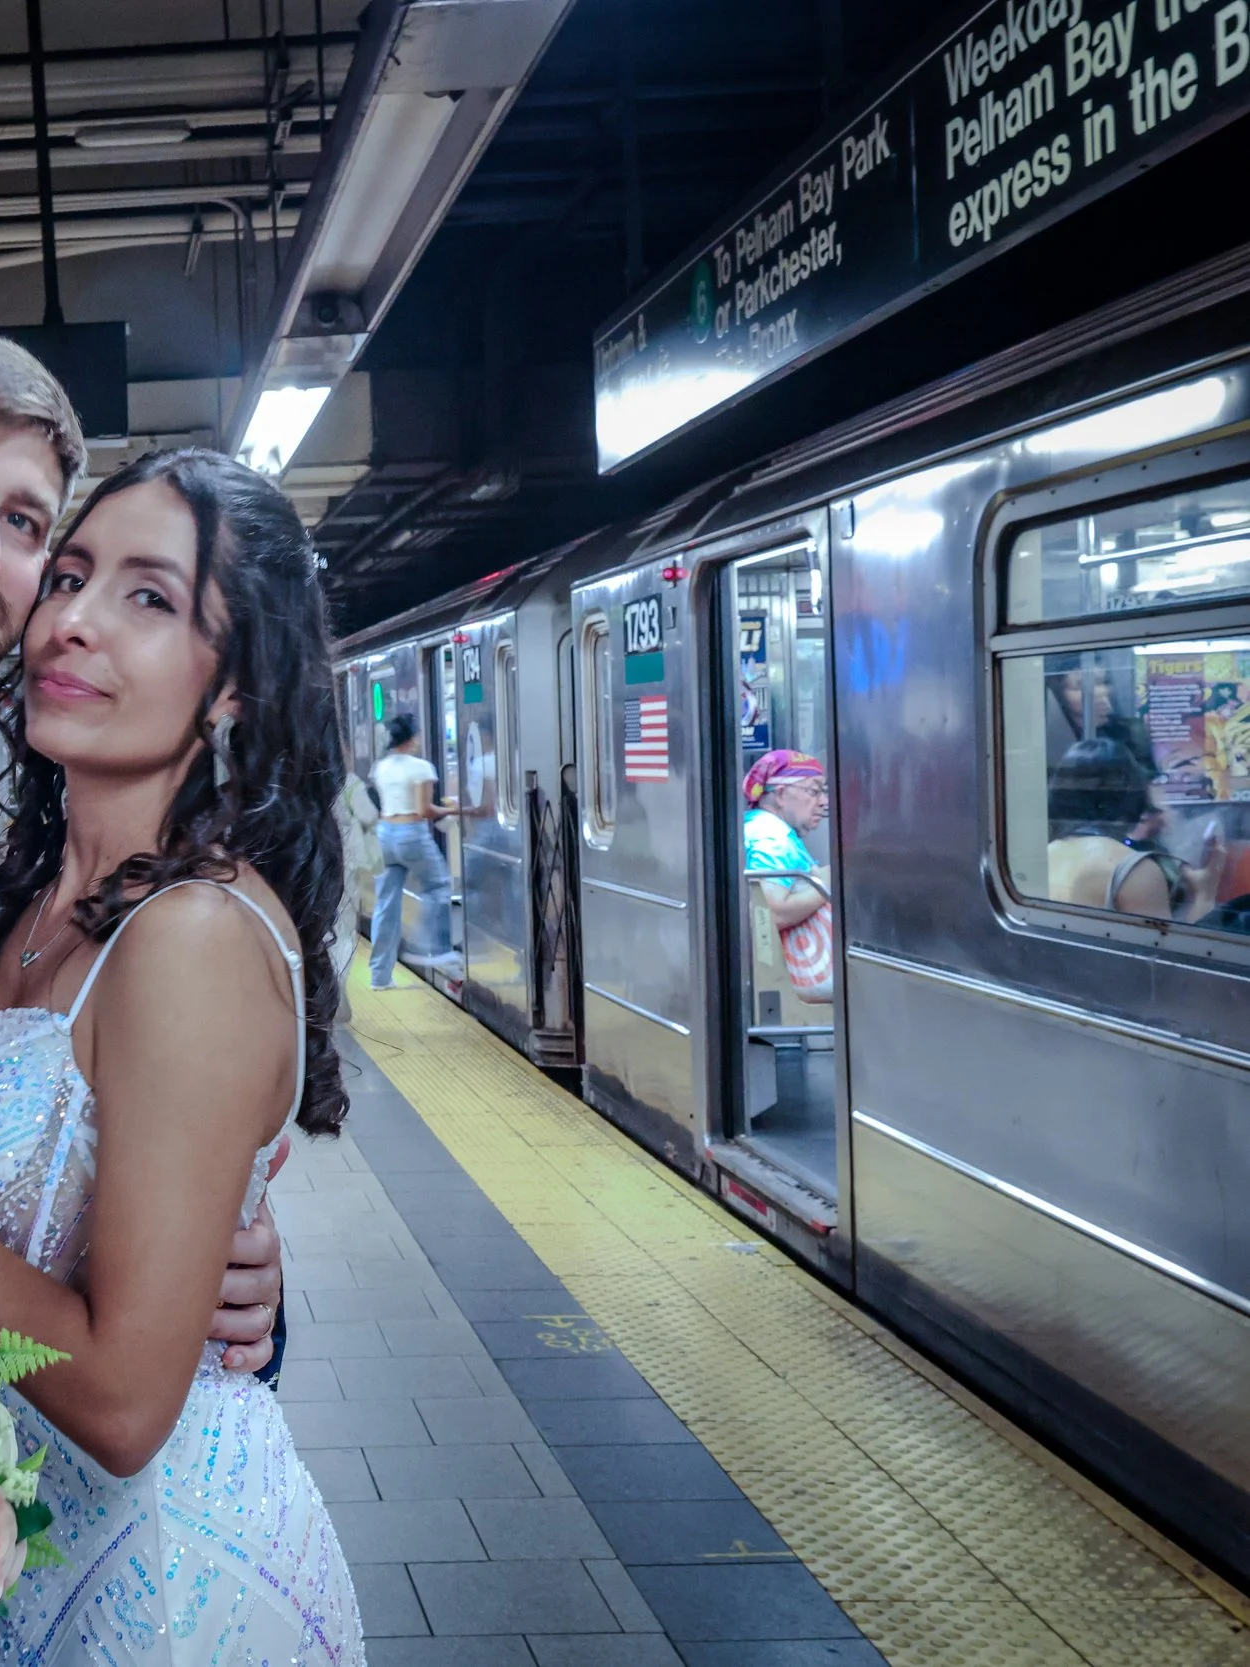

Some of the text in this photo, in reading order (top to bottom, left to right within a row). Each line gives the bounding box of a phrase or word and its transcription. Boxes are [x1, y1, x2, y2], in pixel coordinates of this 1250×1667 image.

[945, 20, 1137, 180] Pelham Bay
[949, 133, 1071, 247] express
[1082, 99, 1116, 167] in
[1129, 52, 1198, 136] the
[713, 112, 890, 289] To Pelham Bay Park
[696, 280, 707, 325] 6
[714, 220, 842, 339] or Parkchester,
[624, 598, 661, 654] 1793
[1151, 659, 1203, 675] Tigers
